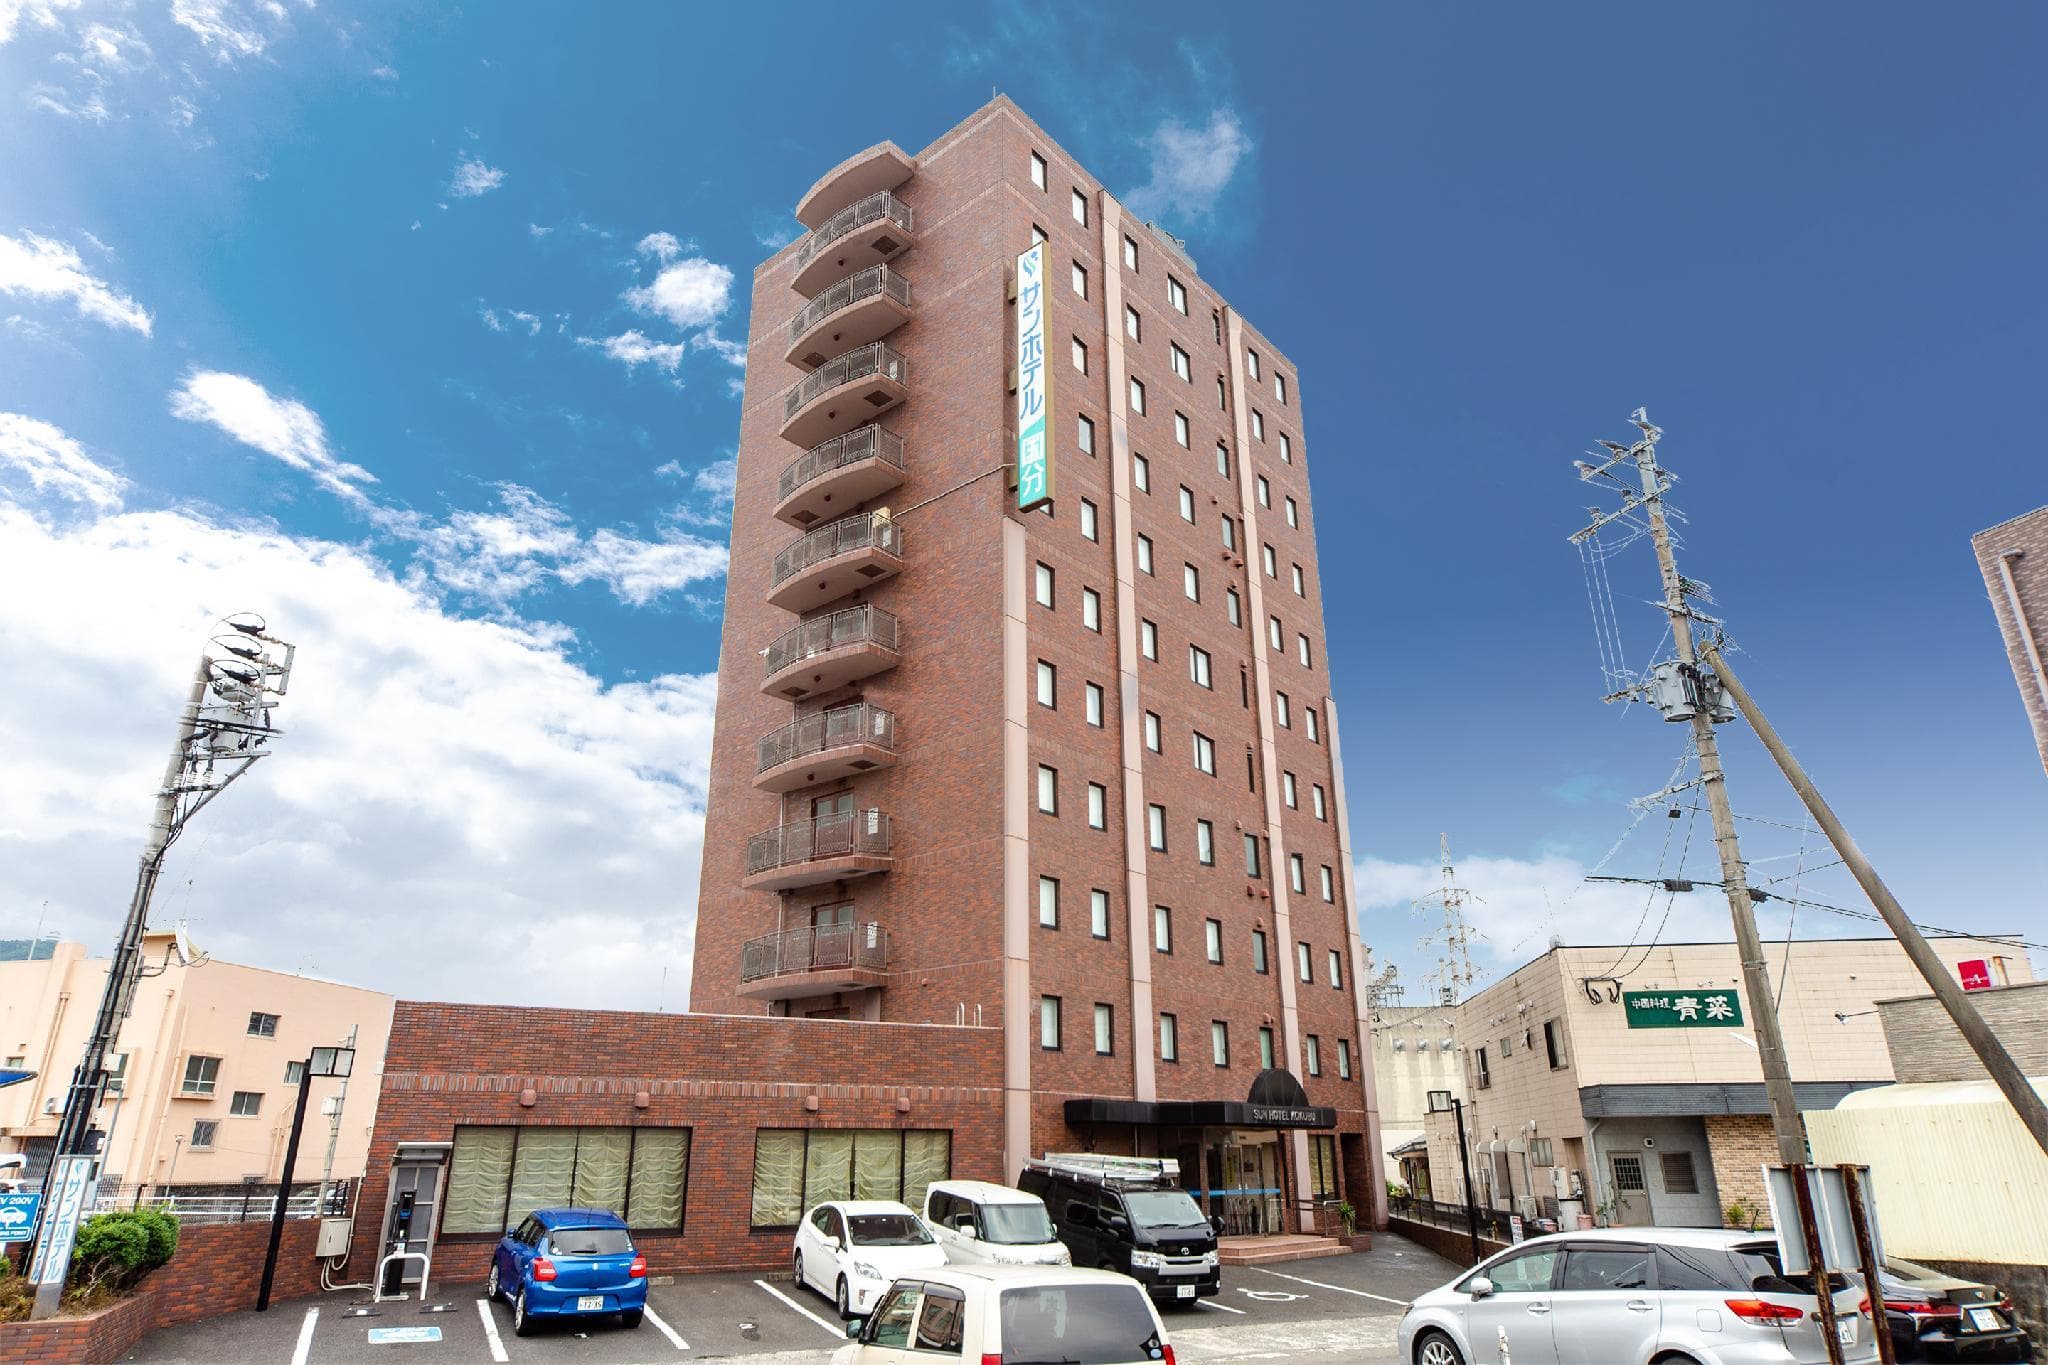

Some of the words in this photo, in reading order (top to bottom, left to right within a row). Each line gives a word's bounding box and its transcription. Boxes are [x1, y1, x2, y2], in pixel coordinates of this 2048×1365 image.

[1020, 281, 1043, 420] サンホテル
[1021, 431, 1045, 498] 国分
[1672, 995, 1735, 1021] 青菜
[1253, 1109, 1267, 1120] SUN
[1268, 1110, 1289, 1120] HOTEL
[8, 1197, 34, 1205] 200V
[44, 1179, 81, 1281] サンホテル
